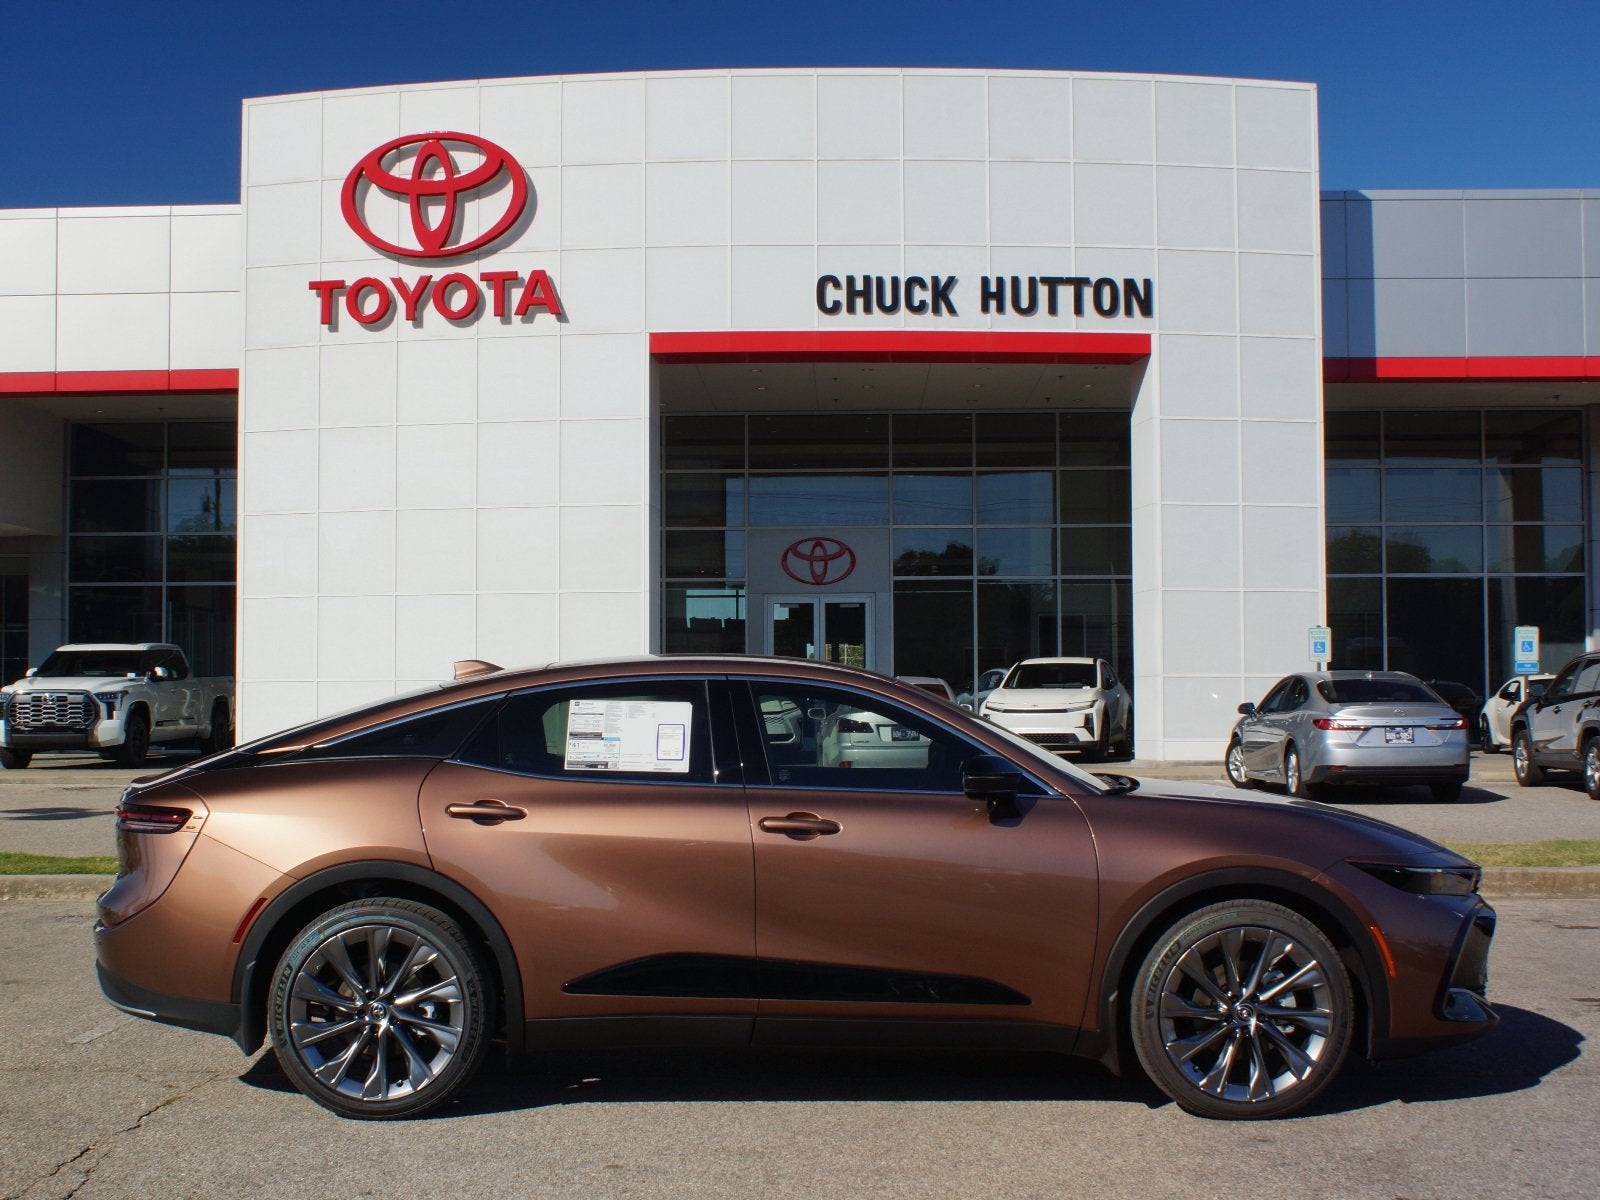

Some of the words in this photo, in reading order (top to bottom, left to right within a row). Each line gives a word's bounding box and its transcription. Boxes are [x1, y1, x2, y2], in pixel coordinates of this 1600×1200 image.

[309, 269, 562, 325] TOYOTA
[816, 274, 958, 316] CHUCK
[980, 276, 1153, 318] HUTTON
[275, 966, 293, 1030] MICHELIN
